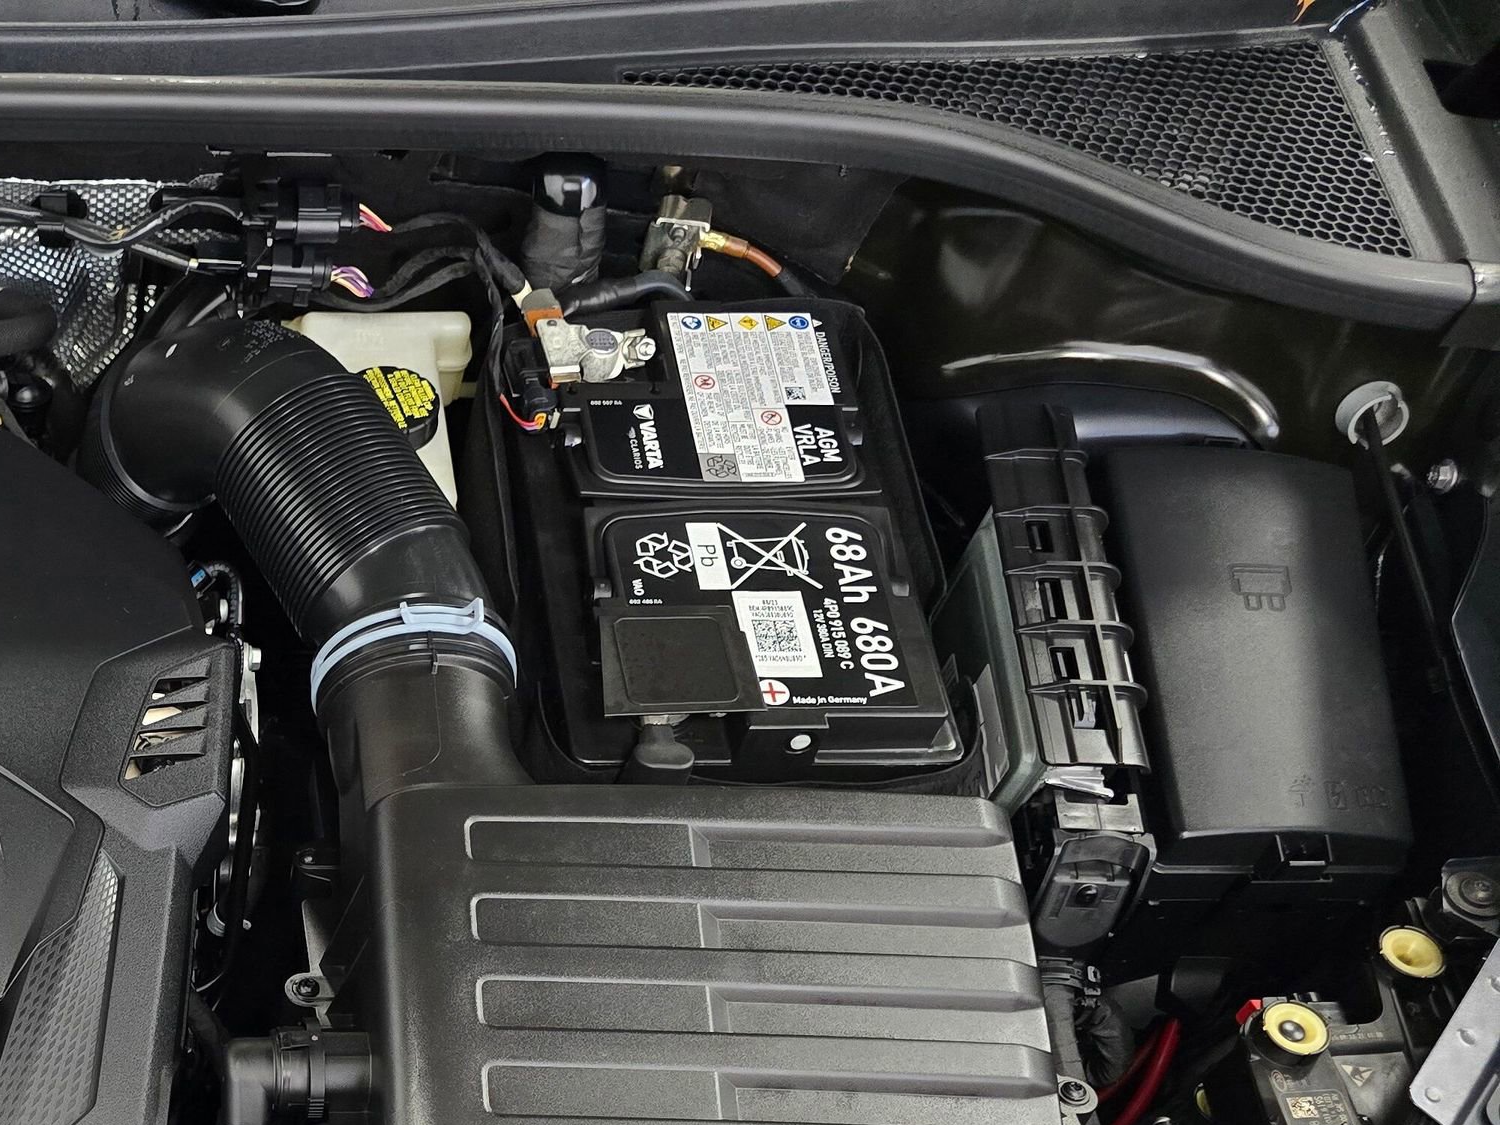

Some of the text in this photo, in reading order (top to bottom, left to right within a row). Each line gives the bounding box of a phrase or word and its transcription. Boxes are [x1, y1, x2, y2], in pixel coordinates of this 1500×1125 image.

[815, 331, 842, 394] DANGER/POISON
[630, 438, 643, 470] CLARIOS
[638, 420, 664, 469] VARTA
[793, 423, 821, 467] VRLA
[814, 426, 843, 464] AGM
[697, 544, 719, 568] Pb
[812, 608, 826, 623] 12V
[821, 643, 835, 658] DIN
[823, 597, 855, 670] 4P0 915 089 C
[825, 527, 906, 698] 68Ah 680A
[792, 695, 816, 705] Made
[827, 695, 868, 705] Germany
